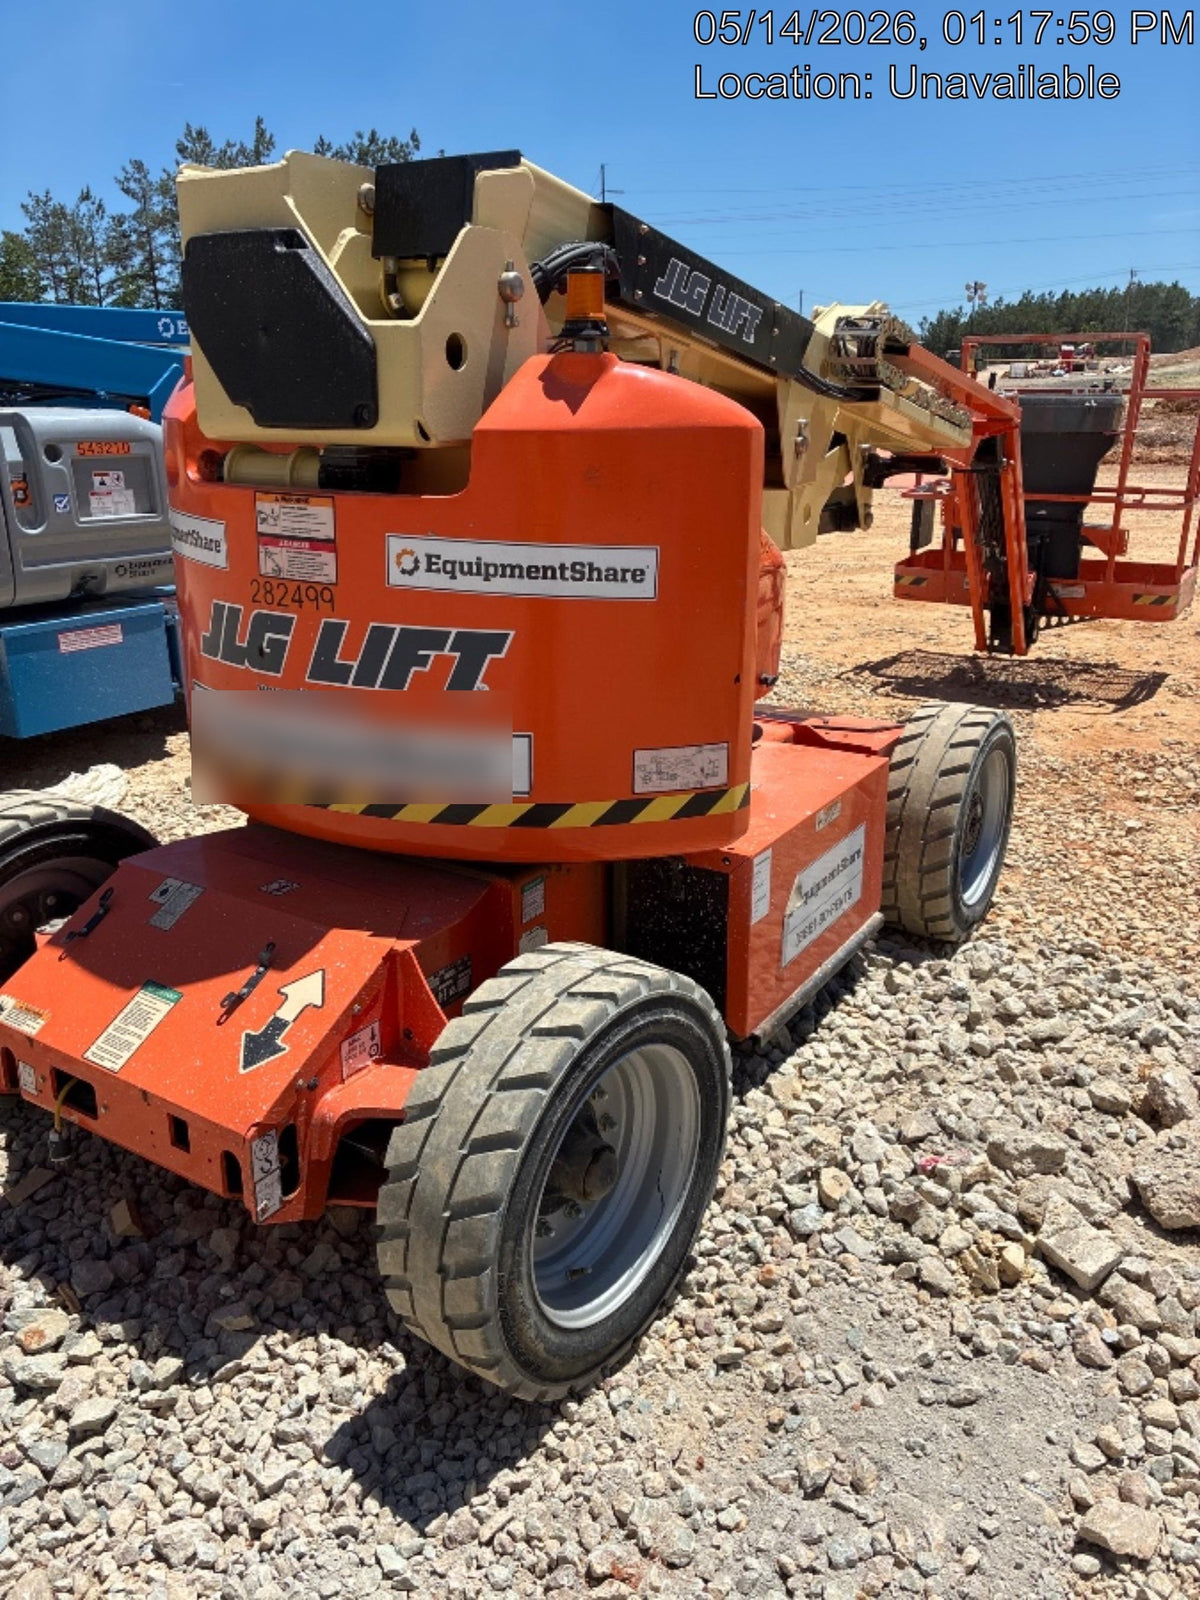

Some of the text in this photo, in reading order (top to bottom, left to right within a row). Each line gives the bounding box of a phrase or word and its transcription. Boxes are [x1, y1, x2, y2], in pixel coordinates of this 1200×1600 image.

[653, 257, 764, 344] JLG LIFT
[249, 578, 335, 613] 282499
[424, 553, 650, 585] EquipmentShare
[200, 599, 515, 691] JLG LIFT
